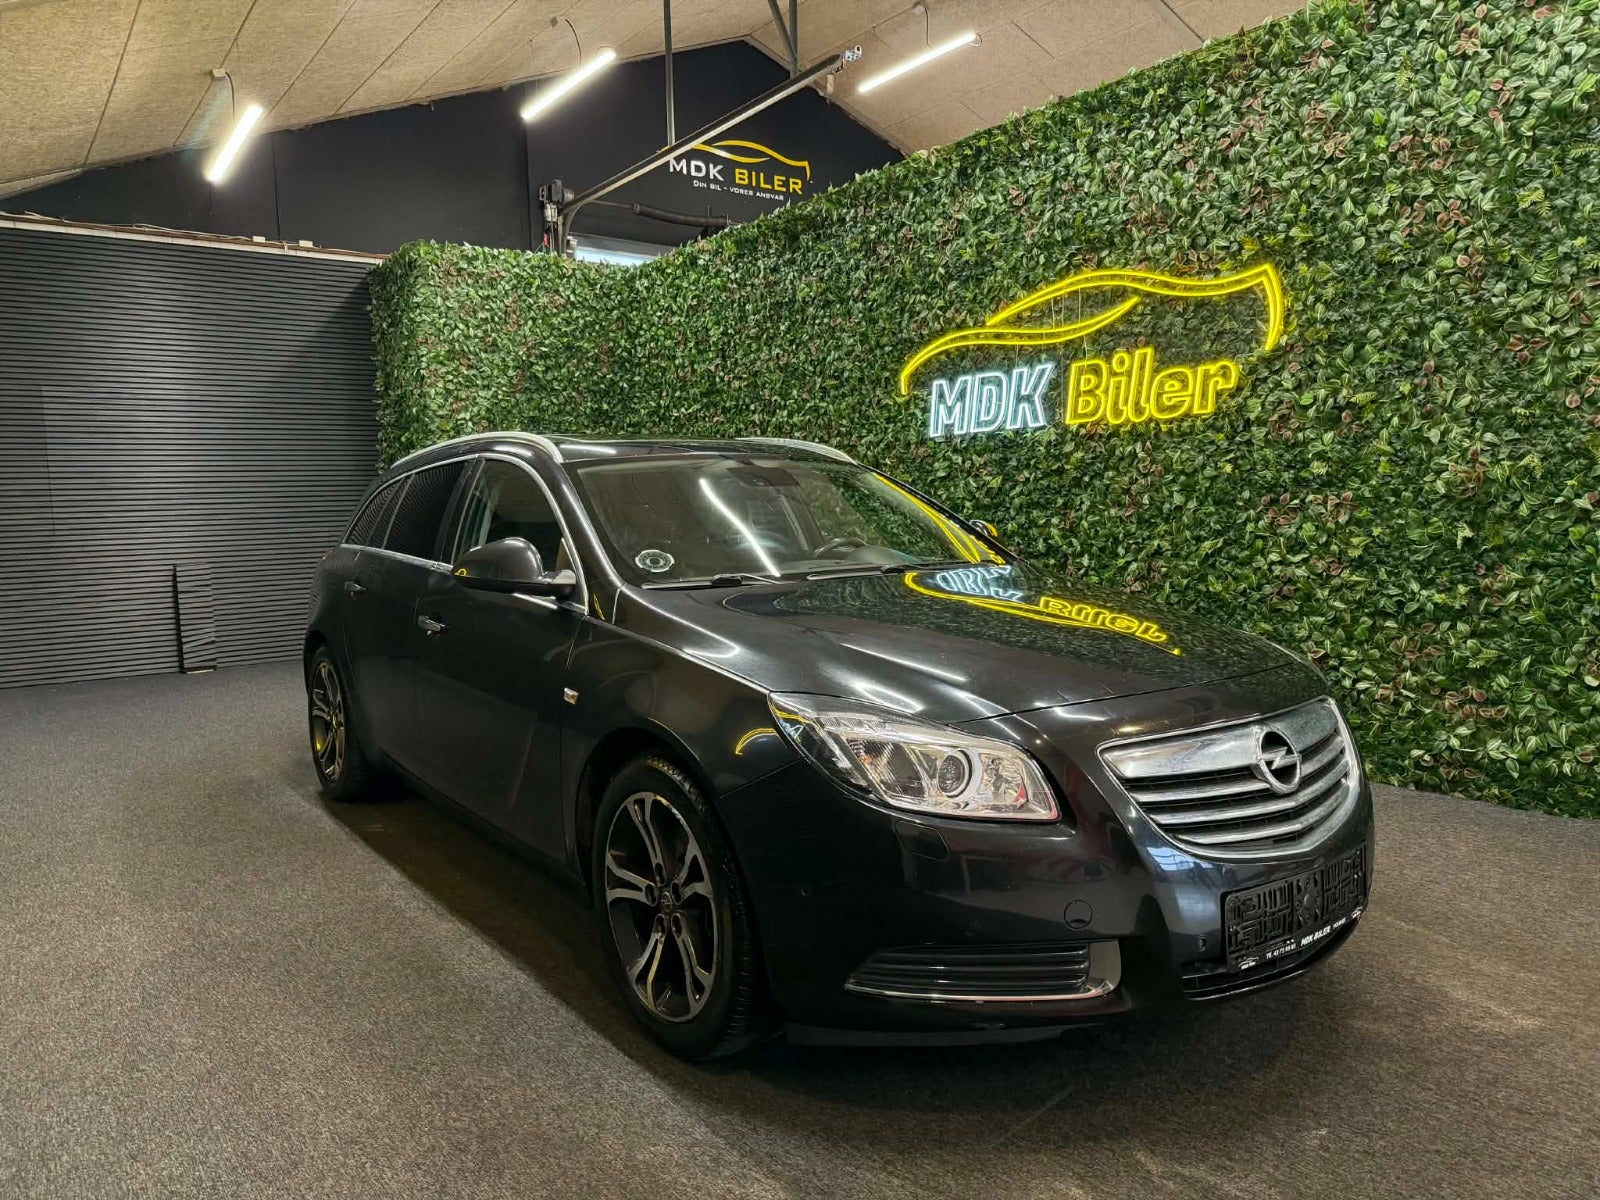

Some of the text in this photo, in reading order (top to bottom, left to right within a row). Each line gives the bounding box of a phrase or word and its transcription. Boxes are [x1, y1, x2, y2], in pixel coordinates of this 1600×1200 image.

[669, 158, 803, 195] MDK BILER
[756, 191, 784, 201] ANSVAR
[928, 345, 1240, 438] MDK Biler
[1313, 925, 1331, 940] BILER
